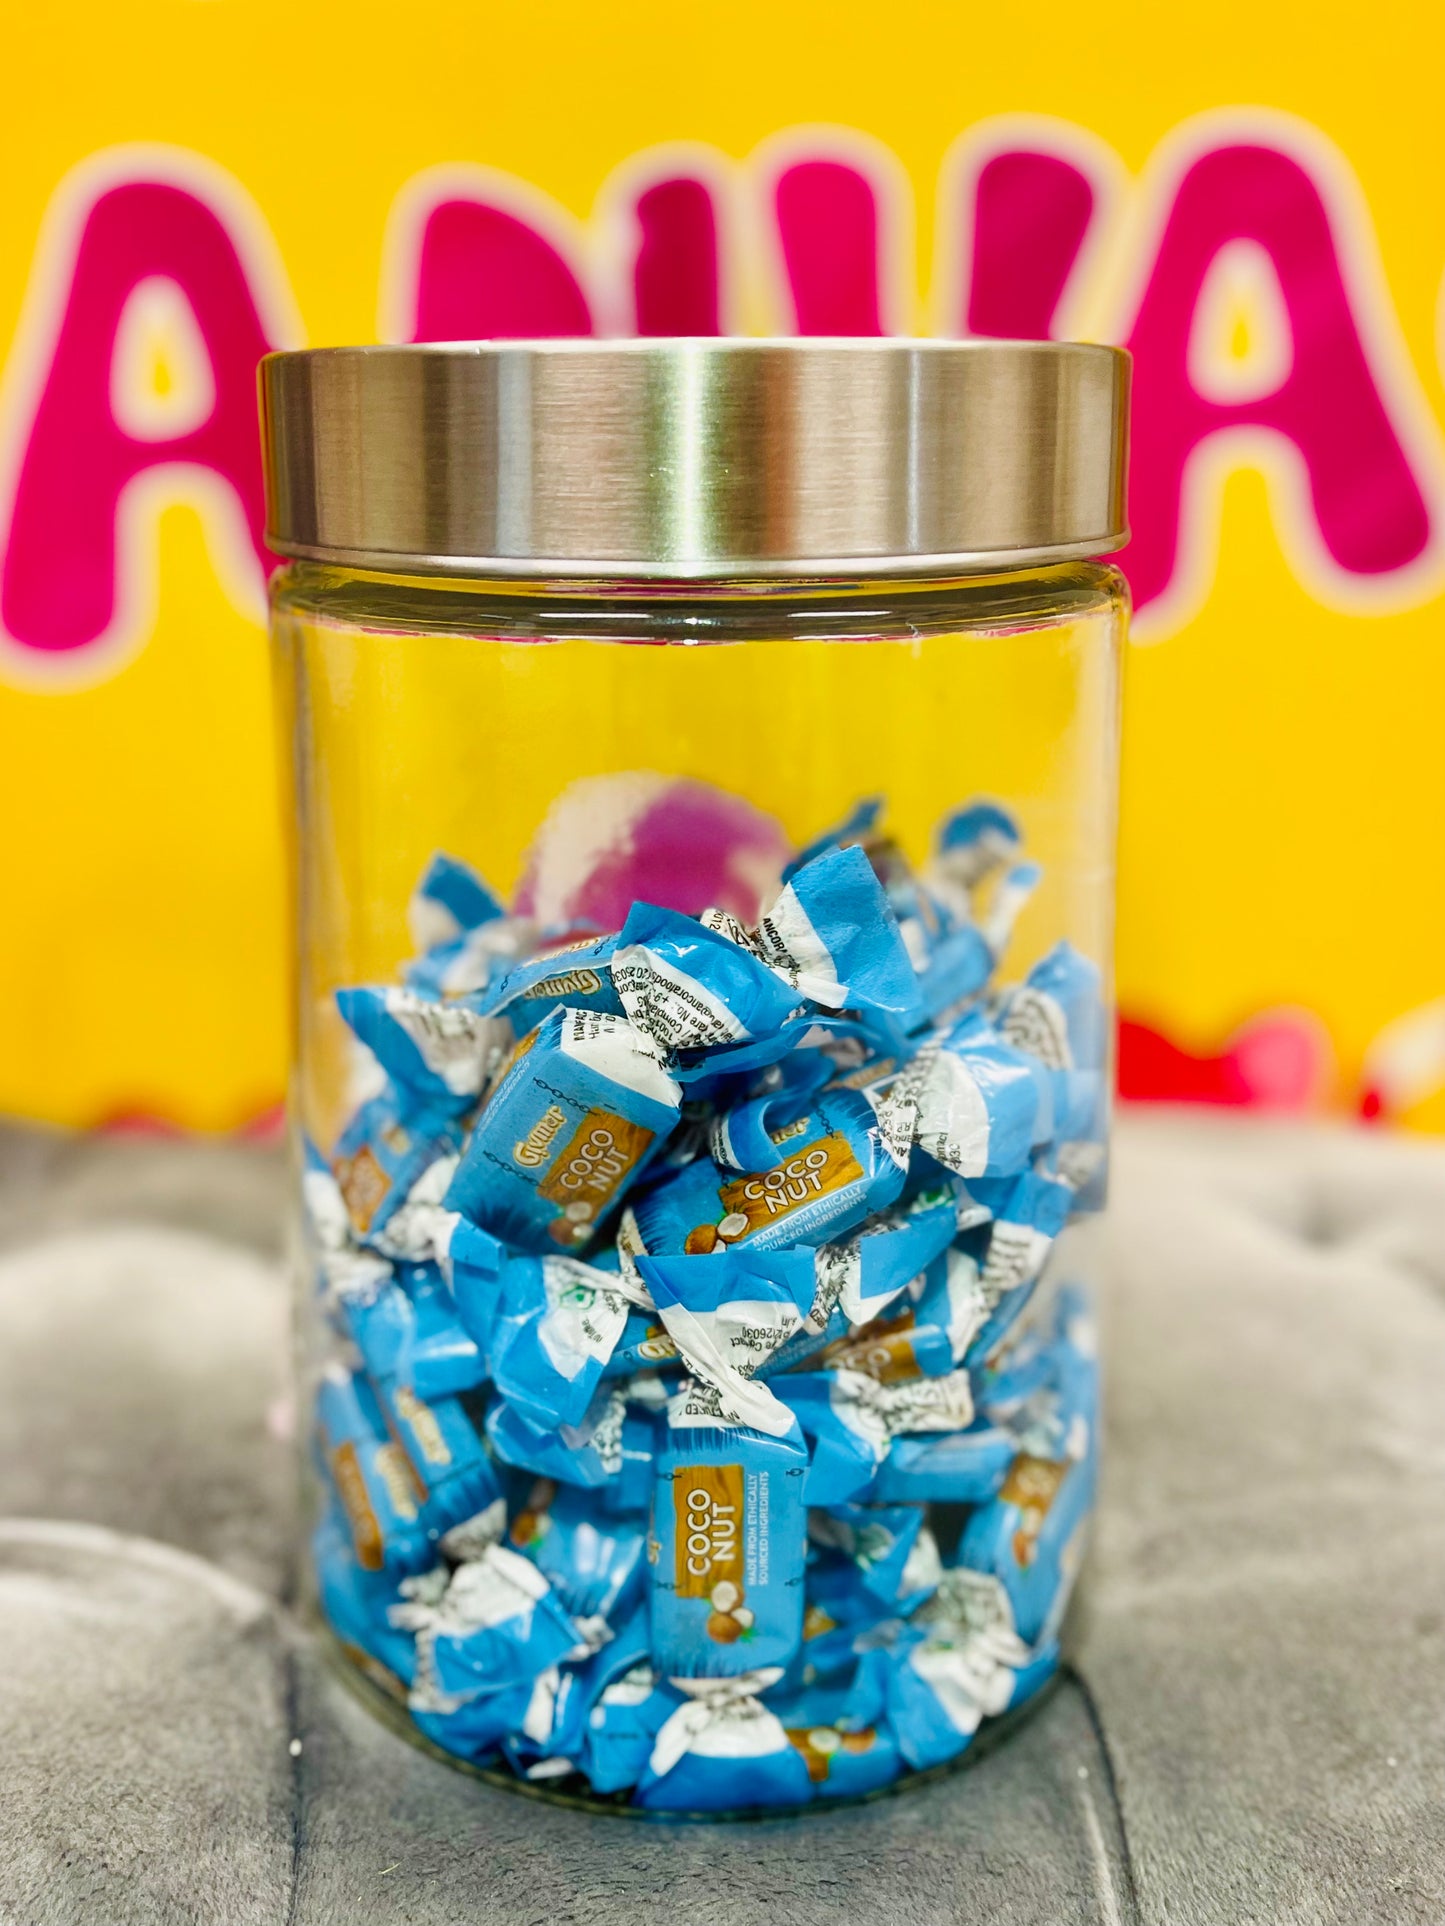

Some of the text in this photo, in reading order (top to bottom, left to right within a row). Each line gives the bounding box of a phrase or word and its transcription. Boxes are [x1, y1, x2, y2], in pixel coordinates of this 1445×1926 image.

[560, 1128, 614, 1190] COCO
[587, 1147, 629, 1192] NUT
[744, 1149, 829, 1200] COCO
[752, 1185, 861, 1247] MADE FROM ETHICALLY
[764, 1169, 823, 1215] NUT
[804, 1193, 867, 1233] INGREDIENTS
[687, 1488, 711, 1576] COCO
[711, 1501, 736, 1561] NUT
[746, 1473, 758, 1586] MADE FROM ETHICALLY
[759, 1471, 770, 1586] SOURCED INGREDIENTS
